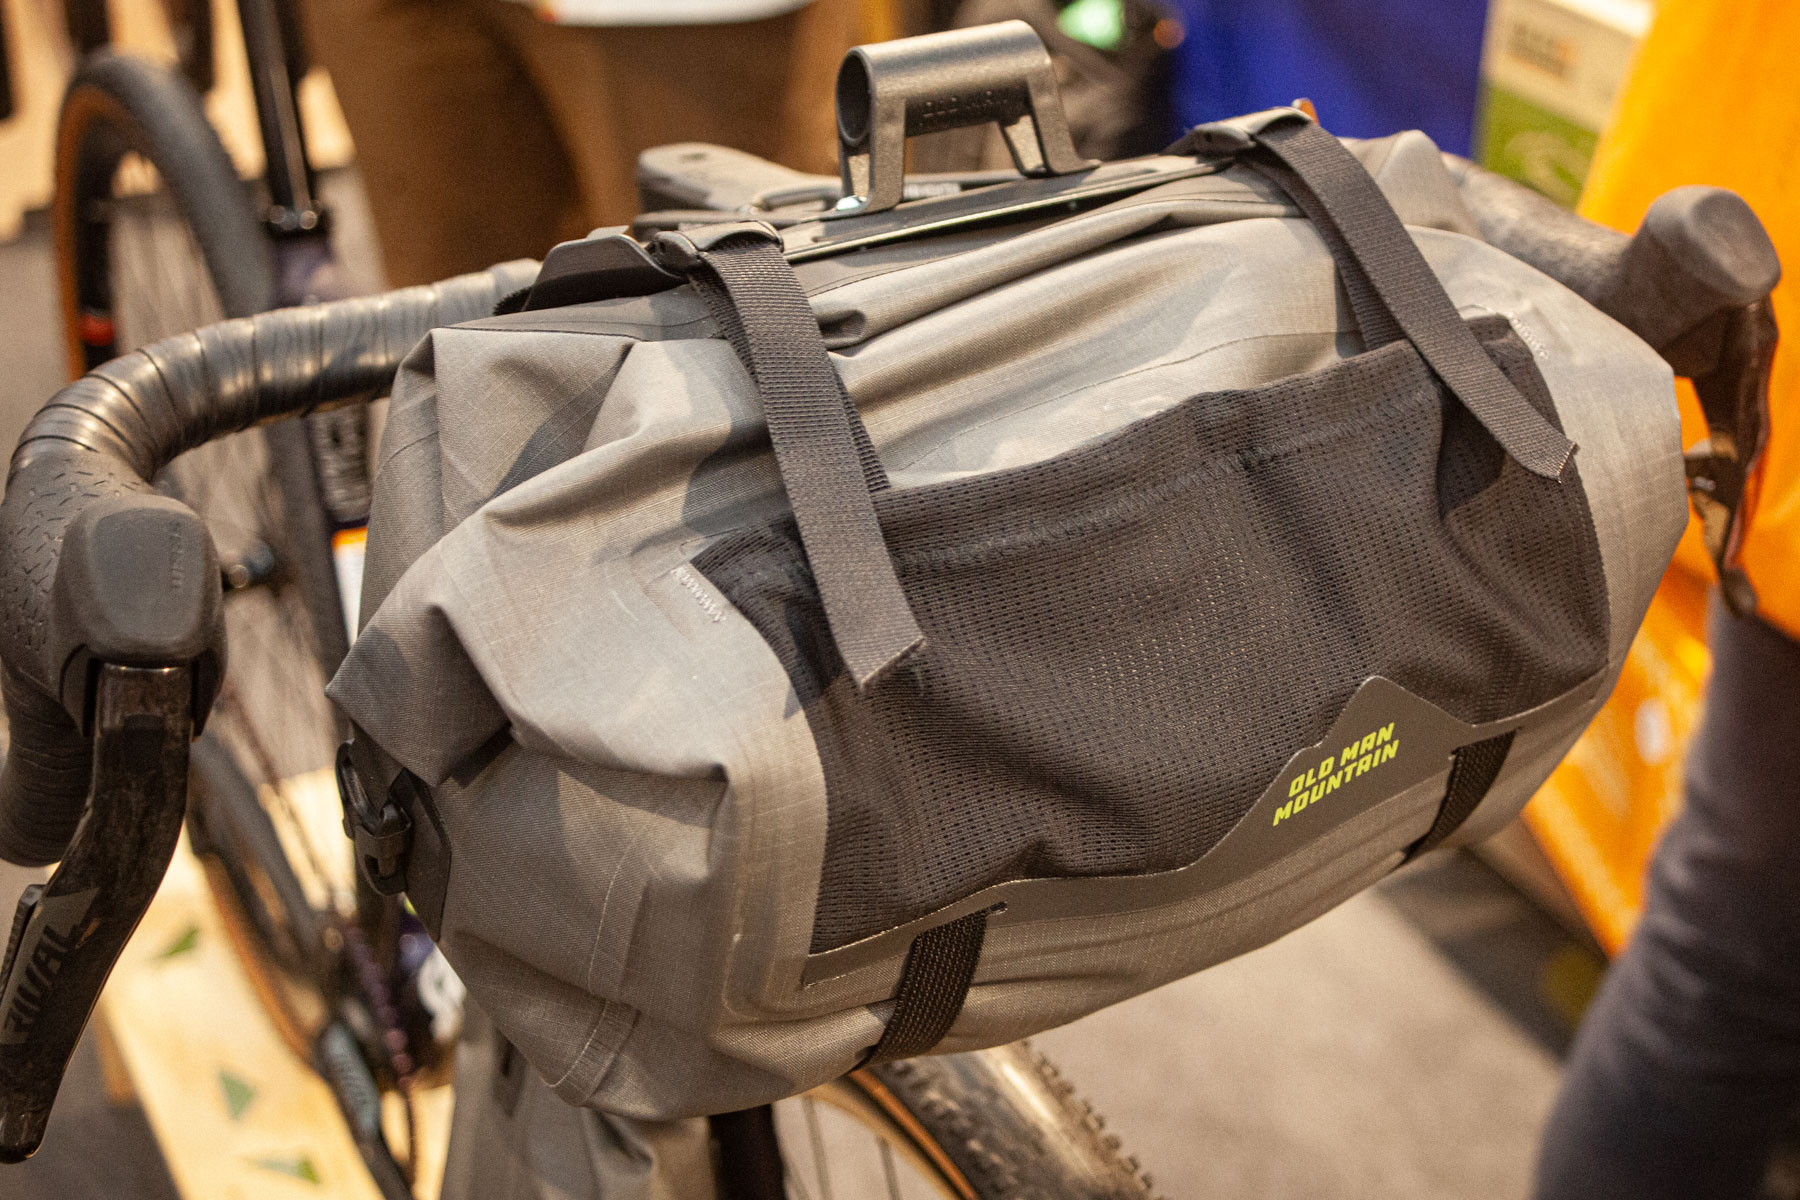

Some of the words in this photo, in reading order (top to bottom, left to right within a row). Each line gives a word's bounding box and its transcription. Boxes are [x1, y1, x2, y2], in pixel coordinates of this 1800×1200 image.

[1272, 739, 1400, 827] MOUNTAIN
[1288, 756, 1335, 798] OLD
[1340, 722, 1395, 766] MAN
[3, 924, 78, 1034] RIVAL
